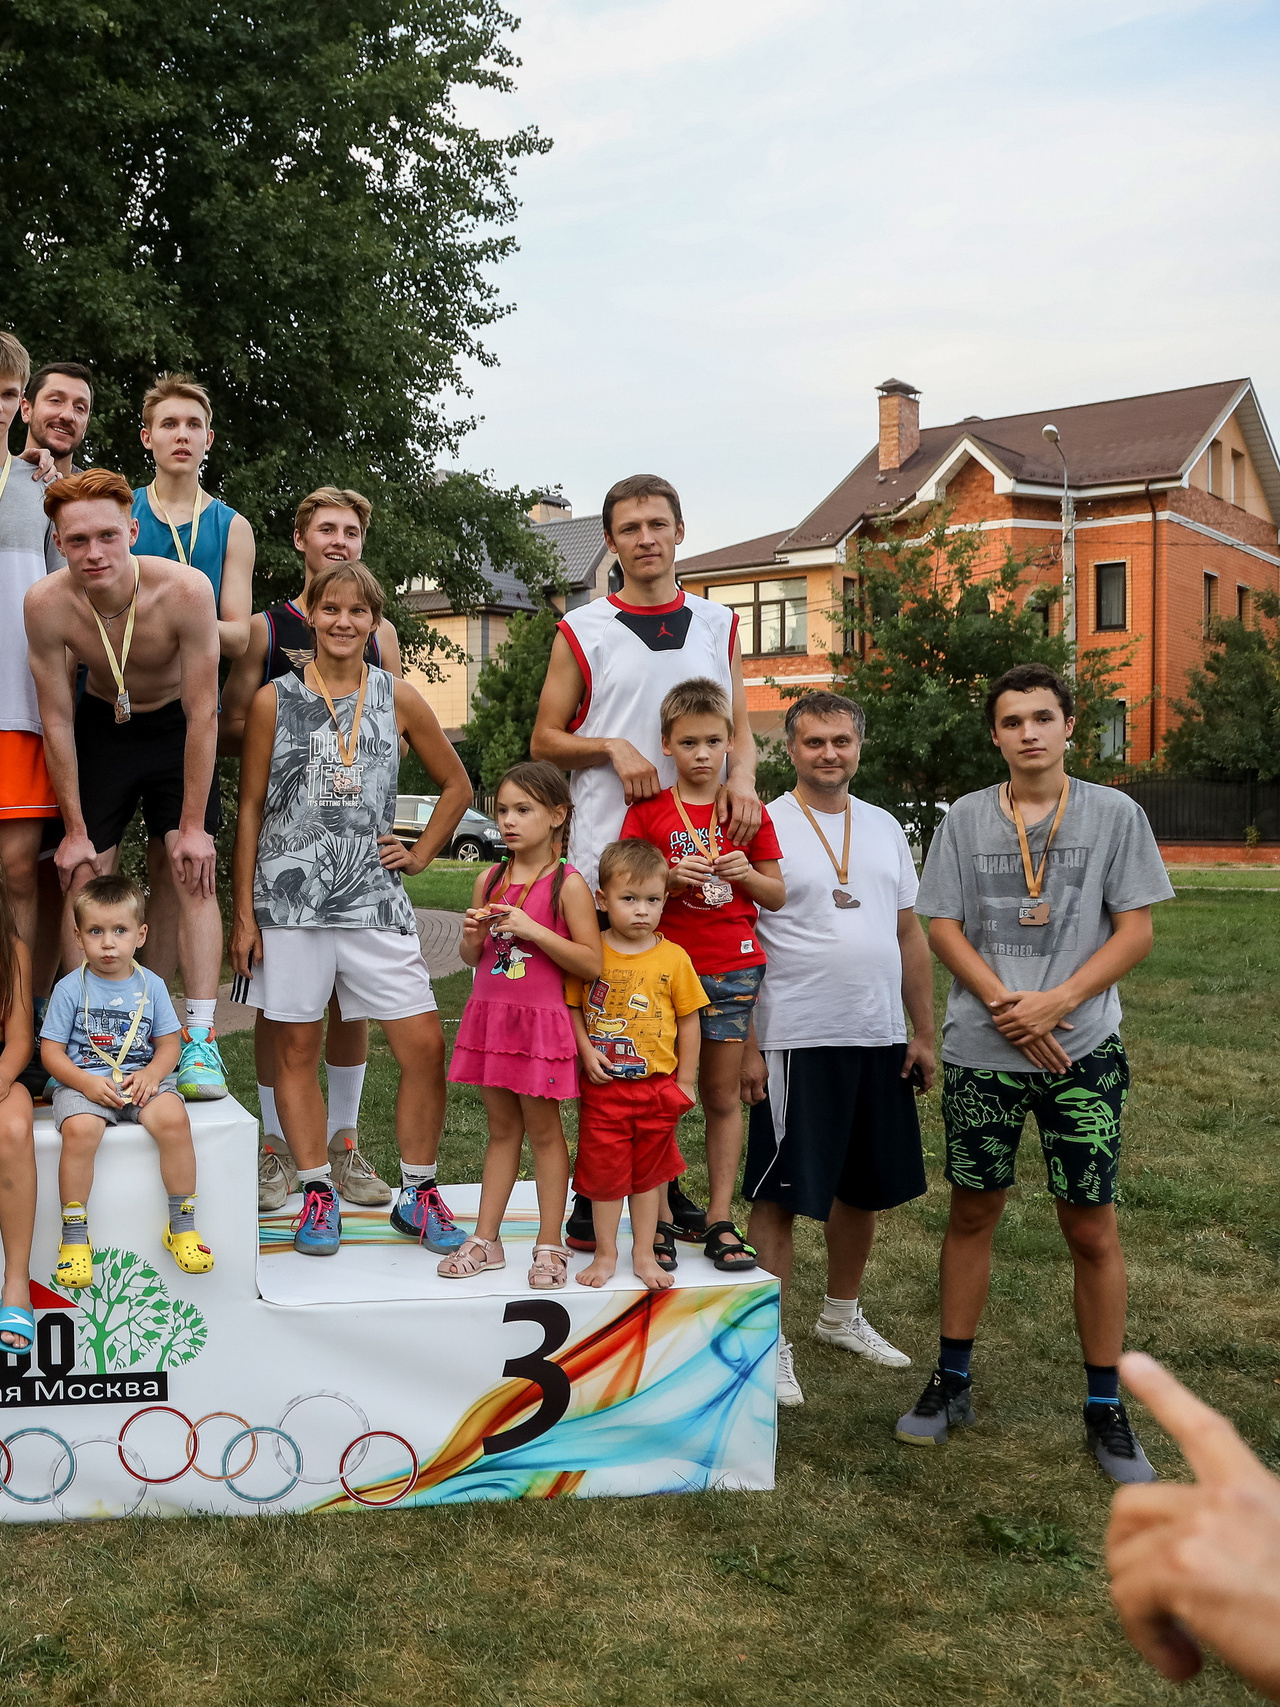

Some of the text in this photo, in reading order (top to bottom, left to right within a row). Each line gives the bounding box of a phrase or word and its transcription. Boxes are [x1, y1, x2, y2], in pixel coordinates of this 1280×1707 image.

[309, 731, 361, 763] PRO
[1086, 1174, 1102, 1202] Never
[34, 1380, 159, 1401] Москва
[482, 1299, 571, 1456] 3
